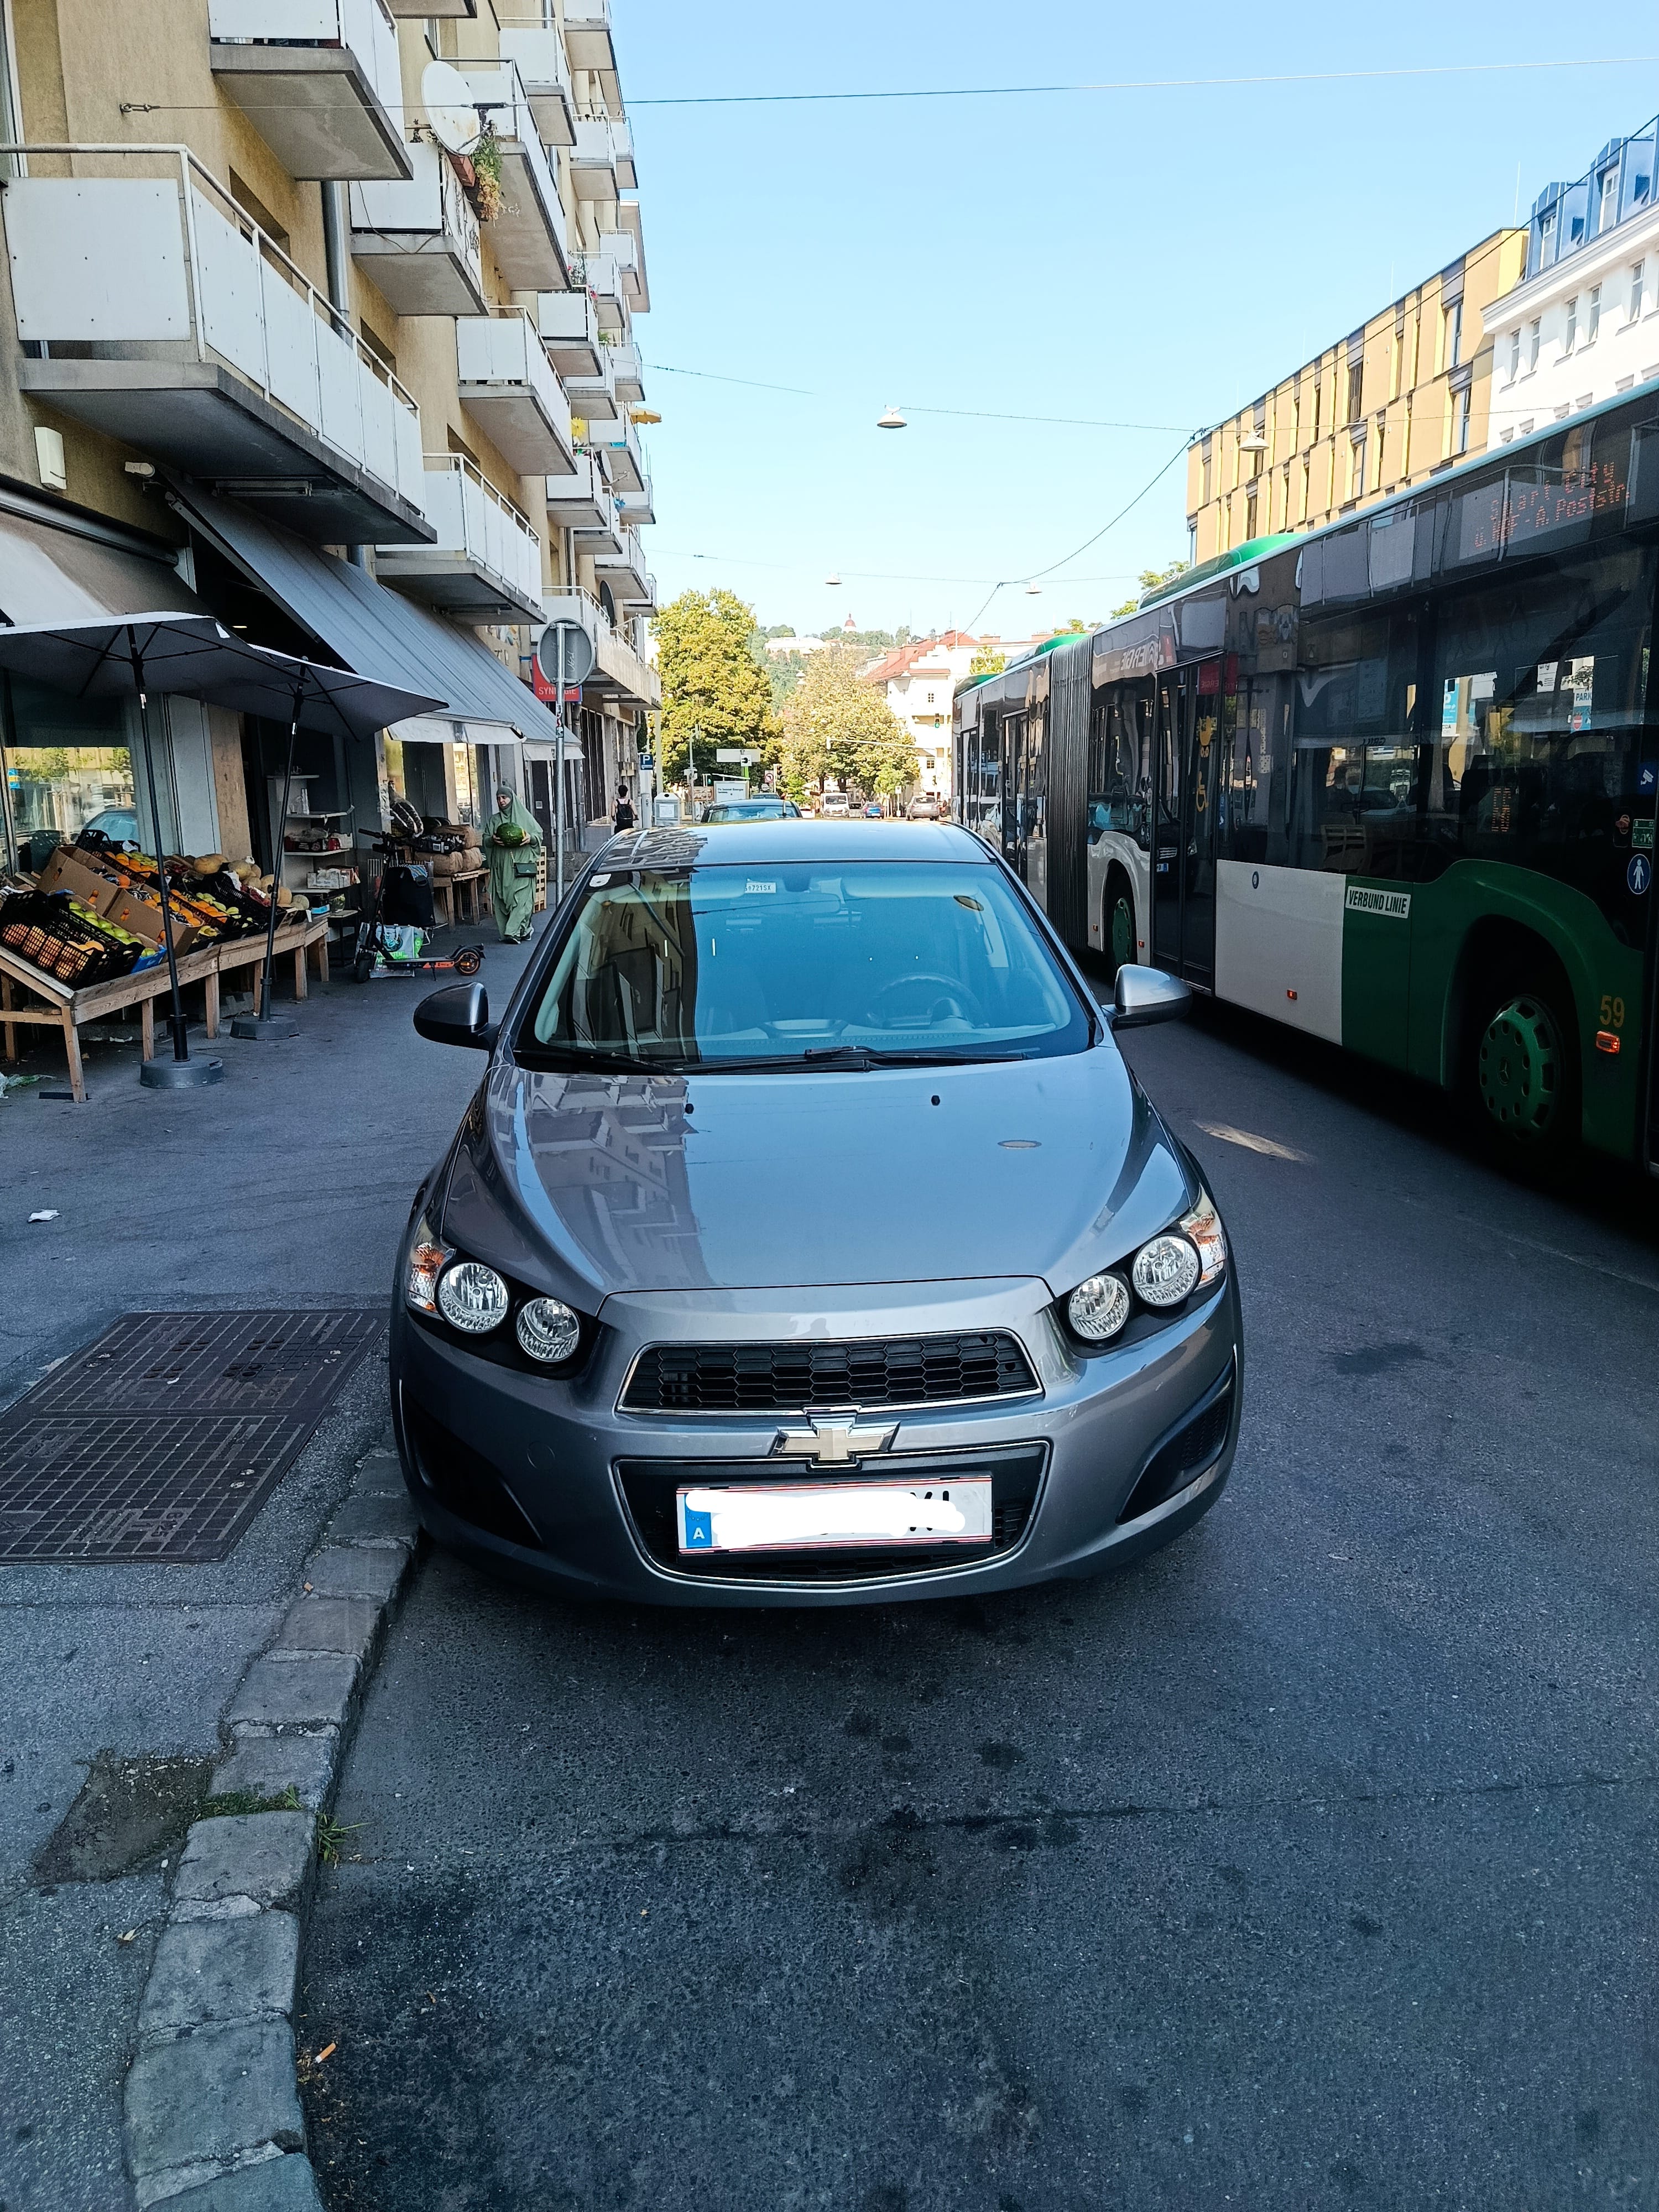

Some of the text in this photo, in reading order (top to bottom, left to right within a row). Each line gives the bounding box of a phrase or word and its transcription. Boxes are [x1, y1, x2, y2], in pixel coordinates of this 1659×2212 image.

[539, 687, 576, 695] SYNGIE
[643, 755, 650, 764] P
[1349, 890, 1407, 914] VERBUND LINIE
[1600, 995, 1625, 1027] 59
[693, 1527, 705, 1540] A
